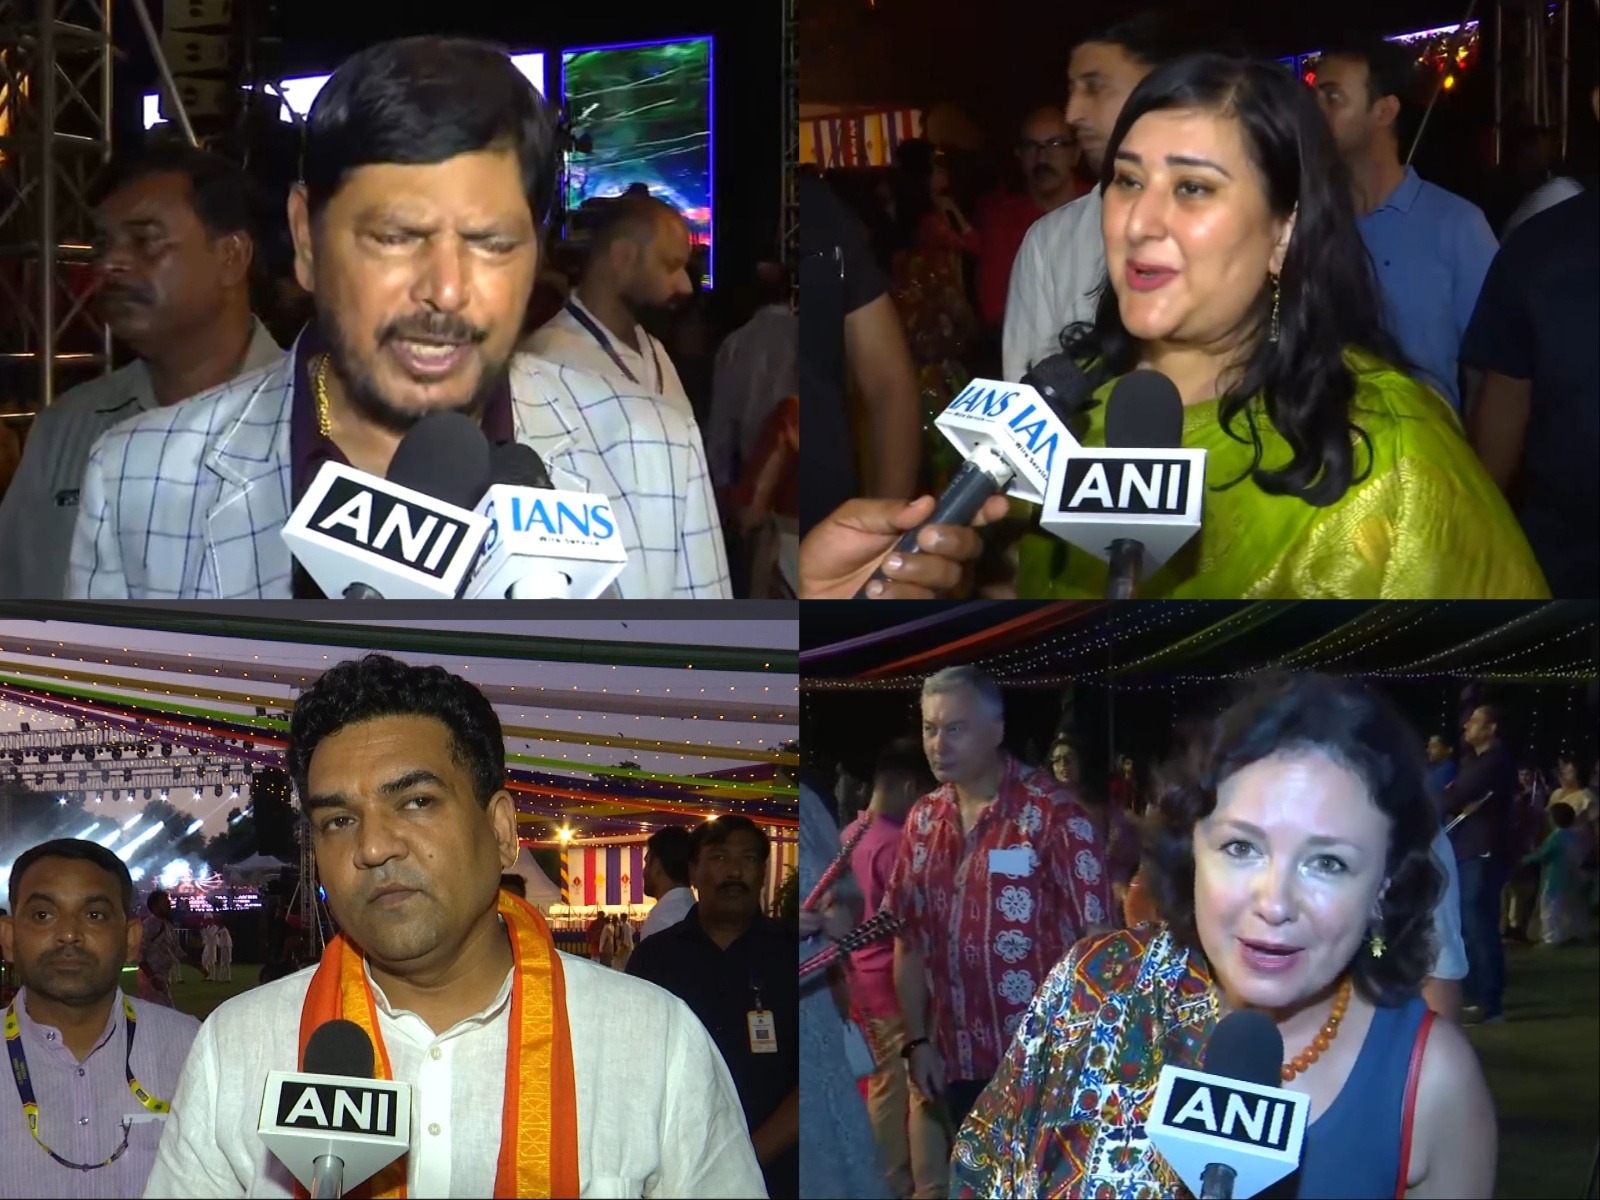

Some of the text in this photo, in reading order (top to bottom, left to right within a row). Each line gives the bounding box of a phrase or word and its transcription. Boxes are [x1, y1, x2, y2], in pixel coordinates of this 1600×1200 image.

[948, 386, 1020, 417] IANS
[1067, 462, 1182, 510] ANI
[318, 489, 458, 571] ANI
[511, 497, 614, 539] IANS
[284, 1086, 389, 1132] ANI
[1172, 1086, 1287, 1146] ANI
